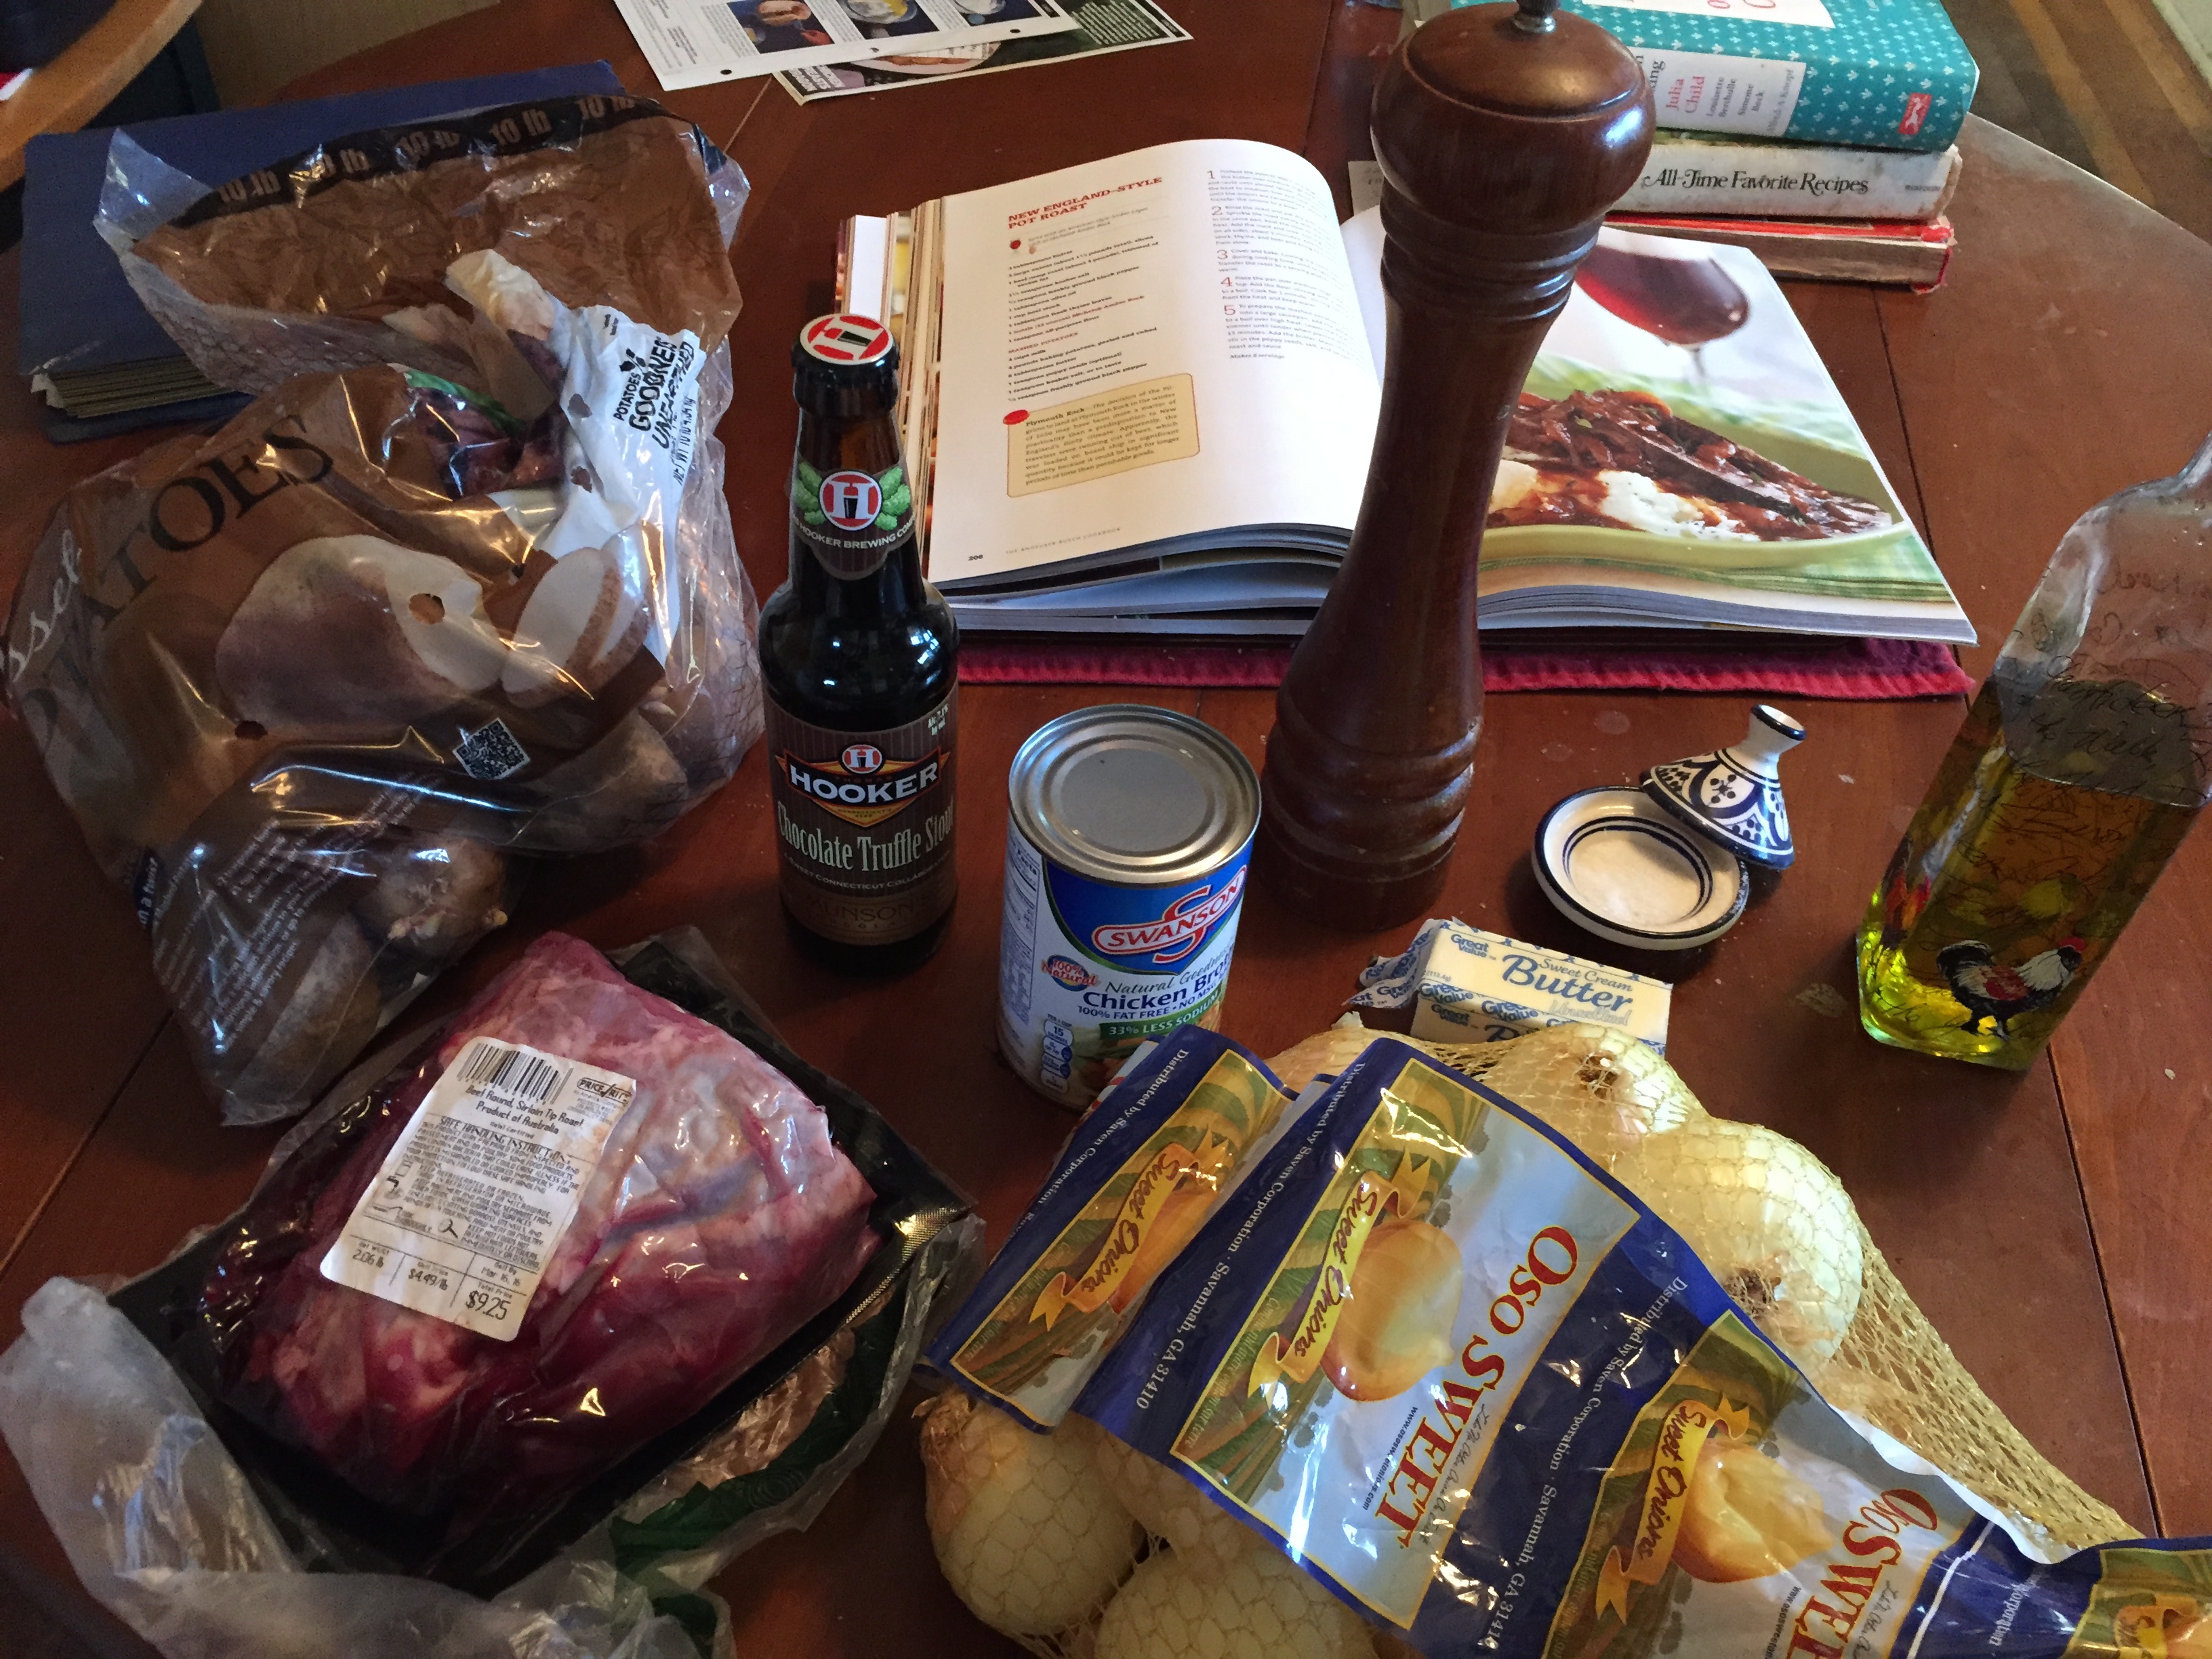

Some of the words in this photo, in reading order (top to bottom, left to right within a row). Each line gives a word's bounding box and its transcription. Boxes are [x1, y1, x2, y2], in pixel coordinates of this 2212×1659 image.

[575, 96, 605, 120] 10
[1666, 79, 1684, 110] Julia
[1685, 76, 1705, 113] Child
[490, 119, 520, 146] 10
[527, 109, 552, 135] lb
[401, 131, 430, 159] 10
[1207, 171, 1215, 179] 1
[1641, 169, 1728, 189] All-Time
[1731, 171, 1797, 189] Favorite
[1800, 173, 1869, 196] Recipes
[1008, 209, 1041, 222] NEW
[1008, 218, 1037, 229] POT
[1040, 203, 1088, 220] ROAST
[1212, 206, 1223, 216] 2
[1217, 249, 1228, 260] 3
[1221, 277, 1233, 287] 4
[1224, 305, 1235, 315] 5
[613, 373, 642, 421] POTATOES
[1025, 411, 1064, 426] Plymouth
[799, 523, 842, 547] HOOKER
[844, 534, 896, 550] BREWING
[790, 761, 938, 804] HOOKER
[777, 800, 853, 870] Chocolate
[857, 828, 921, 872] Truffle
[815, 874, 885, 890] CONNECTICUT
[1107, 877, 1240, 947] SWANSON
[1450, 934, 1490, 951] Great
[1458, 945, 1488, 958] Value
[1042, 961, 1099, 987] Natural
[1052, 958, 1084, 977] 100%
[1501, 954, 1634, 1012] Butter
[1539, 957, 1581, 979] Sweet
[1584, 970, 1634, 993] Cream
[1083, 987, 1187, 1010] Chicken
[1105, 977, 1174, 994] Natural
[1435, 989, 1474, 1004] Value
[1078, 1005, 1110, 1019] 100%
[1113, 1010, 1136, 1020] FAT
[1139, 1006, 1170, 1019] FREE
[1179, 996, 1195, 1009] NO
[1108, 1025, 1139, 1036] 33%
[1142, 1021, 1174, 1033] LESS
[1174, 989, 1220, 1026] SODIUM
[1498, 1008, 1538, 1022] Value
[1052, 1025, 1066, 1037] 15
[579, 1080, 606, 1097] PRICE
[1134, 1046, 1189, 1109] Distributed
[485, 1088, 516, 1108] Round,
[516, 1099, 544, 1117] Sirloin
[544, 1108, 558, 1122] Tip
[1311, 1057, 1367, 1132] Distributed
[475, 1099, 512, 1120] Product
[510, 1111, 523, 1124] of
[521, 1114, 560, 1136] Australia
[1121, 1102, 1139, 1120] by
[461, 1122, 506, 1145] HANDLING
[1092, 1113, 1126, 1151] Saven
[1301, 1124, 1324, 1148] by
[1036, 1141, 1097, 1210] Corporation
[1276, 1141, 1313, 1187] Saven
[1128, 1153, 1180, 1220] Sweet
[1225, 1175, 1286, 1258] Corporation
[1328, 1184, 1380, 1264] Sweet
[375, 1256, 385, 1269] lb
[1080, 1219, 1141, 1296] Onions
[480, 1267, 497, 1279] Mar
[512, 1277, 522, 1287] 16
[463, 1288, 512, 1322] $9.25
[1173, 1258, 1232, 1338] Savannah,
[1293, 1265, 1355, 1359] Onions
[1626, 1267, 1690, 1354] Distributed
[1160, 1335, 1187, 1366] GA
[1613, 1338, 1637, 1360] by
[1132, 1361, 1172, 1412] 31410
[1589, 1352, 1626, 1400] Saven
[1375, 1334, 1507, 1550] SWEET
[1544, 1390, 1602, 1477] Corporation
[1656, 1406, 1708, 1465] Sweet
[1634, 1463, 1687, 1560] Onions
[1504, 1482, 1567, 1573] Savannah,
[1501, 1570, 1528, 1601] GA
